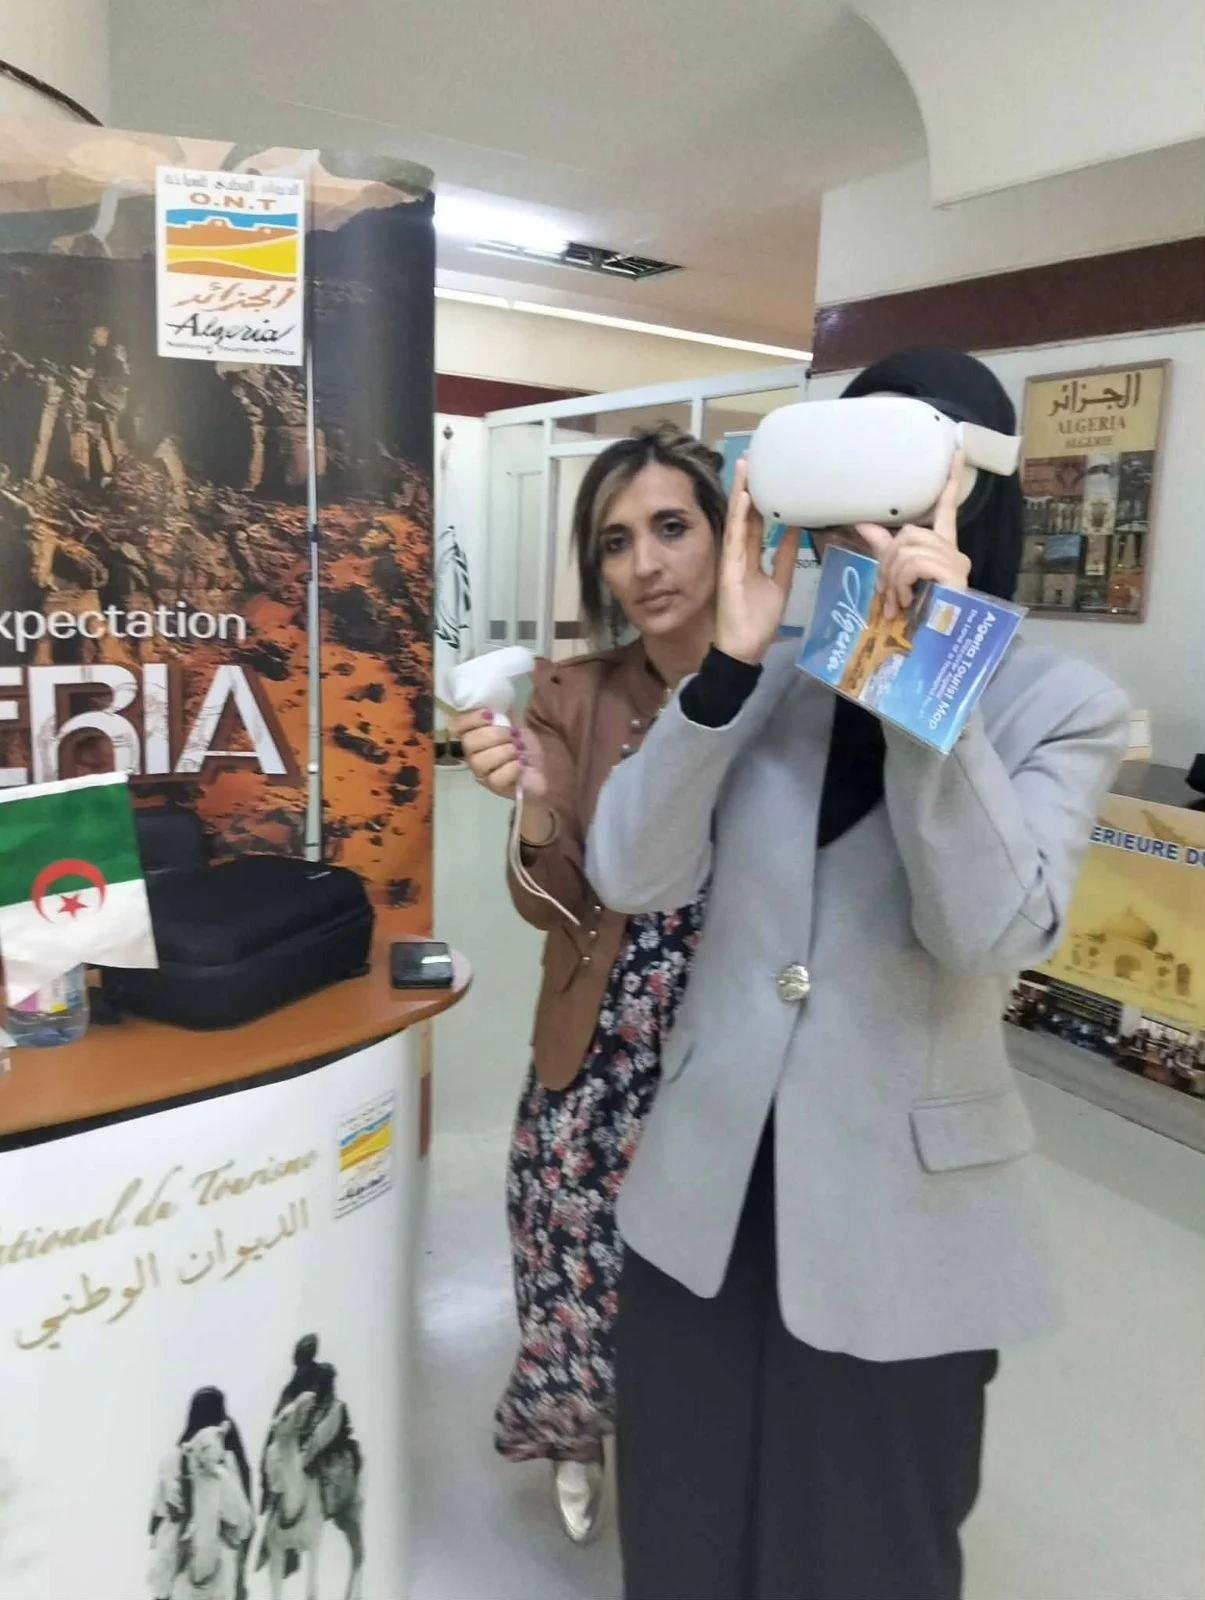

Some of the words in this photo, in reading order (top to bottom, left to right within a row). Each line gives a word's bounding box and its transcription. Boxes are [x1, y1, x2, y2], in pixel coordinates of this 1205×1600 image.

[189, 193, 276, 211] O.N.T
[165, 313, 296, 344] Algeria
[1048, 372, 1141, 417] الجزائر
[966, 611, 996, 658] Algeria
[944, 661, 973, 700] Tourist
[928, 701, 950, 731] Map
